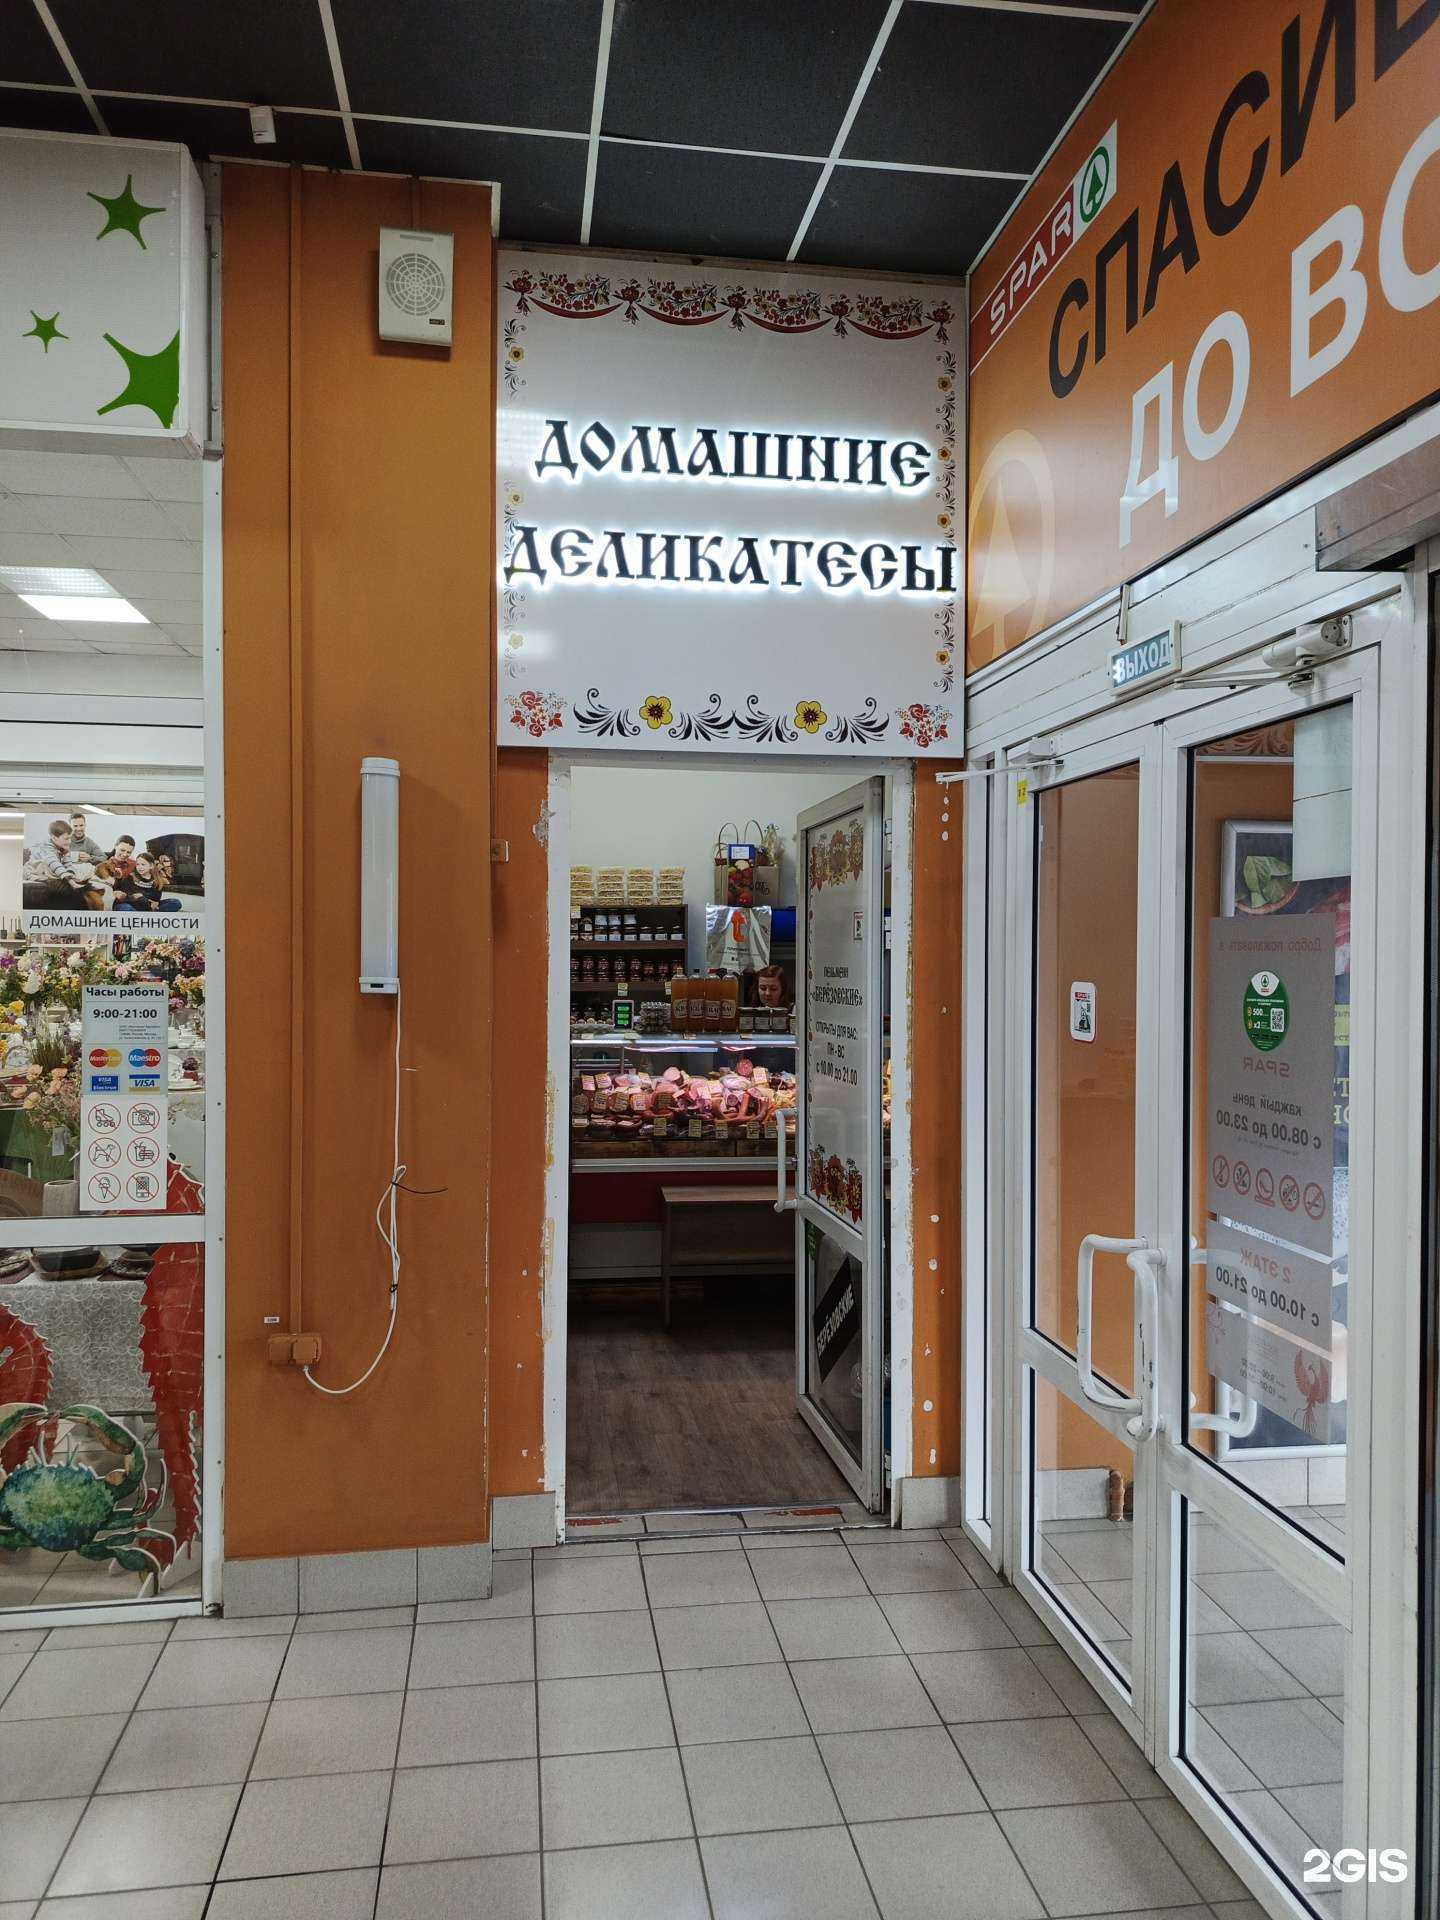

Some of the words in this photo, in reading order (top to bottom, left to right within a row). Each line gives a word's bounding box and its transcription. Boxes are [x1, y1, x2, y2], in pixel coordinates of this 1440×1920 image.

[988, 204, 1072, 336] SPAR
[1119, 310, 1251, 550] ДО
[535, 419, 931, 487] ДОМАШНИЕ
[504, 525, 957, 592] ДЕЛИКАТЕСЫ
[1113, 635, 1171, 684] ВЫХОД
[30, 915, 117, 929] ДОМАШНИЕ
[121, 917, 199, 930] ЦЕННОСТИ
[87, 987, 117, 997] Часы
[120, 987, 165, 998] работы
[93, 1008, 158, 1019] 9:00-21:00
[129, 1054, 160, 1062] Maestro
[134, 1079, 155, 1087] VISA
